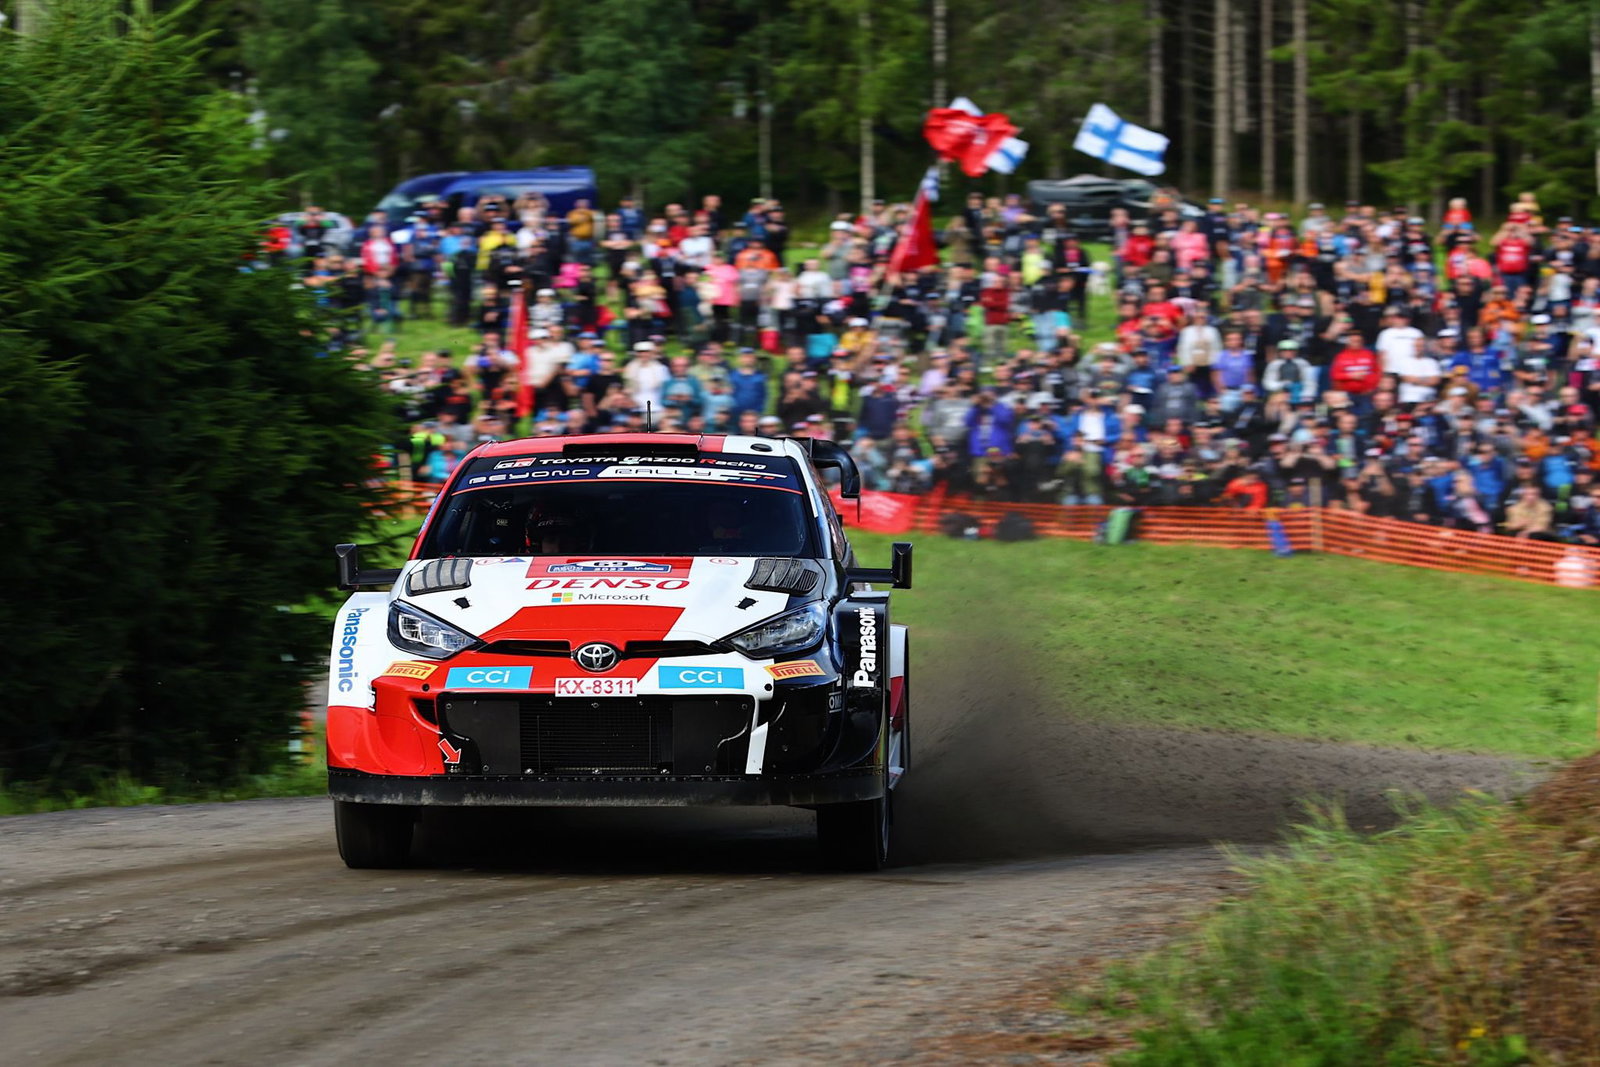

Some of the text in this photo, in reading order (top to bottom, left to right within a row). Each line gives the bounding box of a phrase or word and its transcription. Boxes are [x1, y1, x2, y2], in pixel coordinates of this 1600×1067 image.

[621, 456, 695, 465] GAZOO
[700, 458, 767, 470] Racing
[469, 468, 711, 485] BEYOND RALLY
[525, 579, 690, 590] DENSO
[578, 593, 650, 602] Microsoft
[338, 607, 370, 693] Panasonic
[385, 664, 431, 677] PIRELLI
[769, 662, 820, 678] PIRELLI
[556, 679, 634, 695] KX-8311
